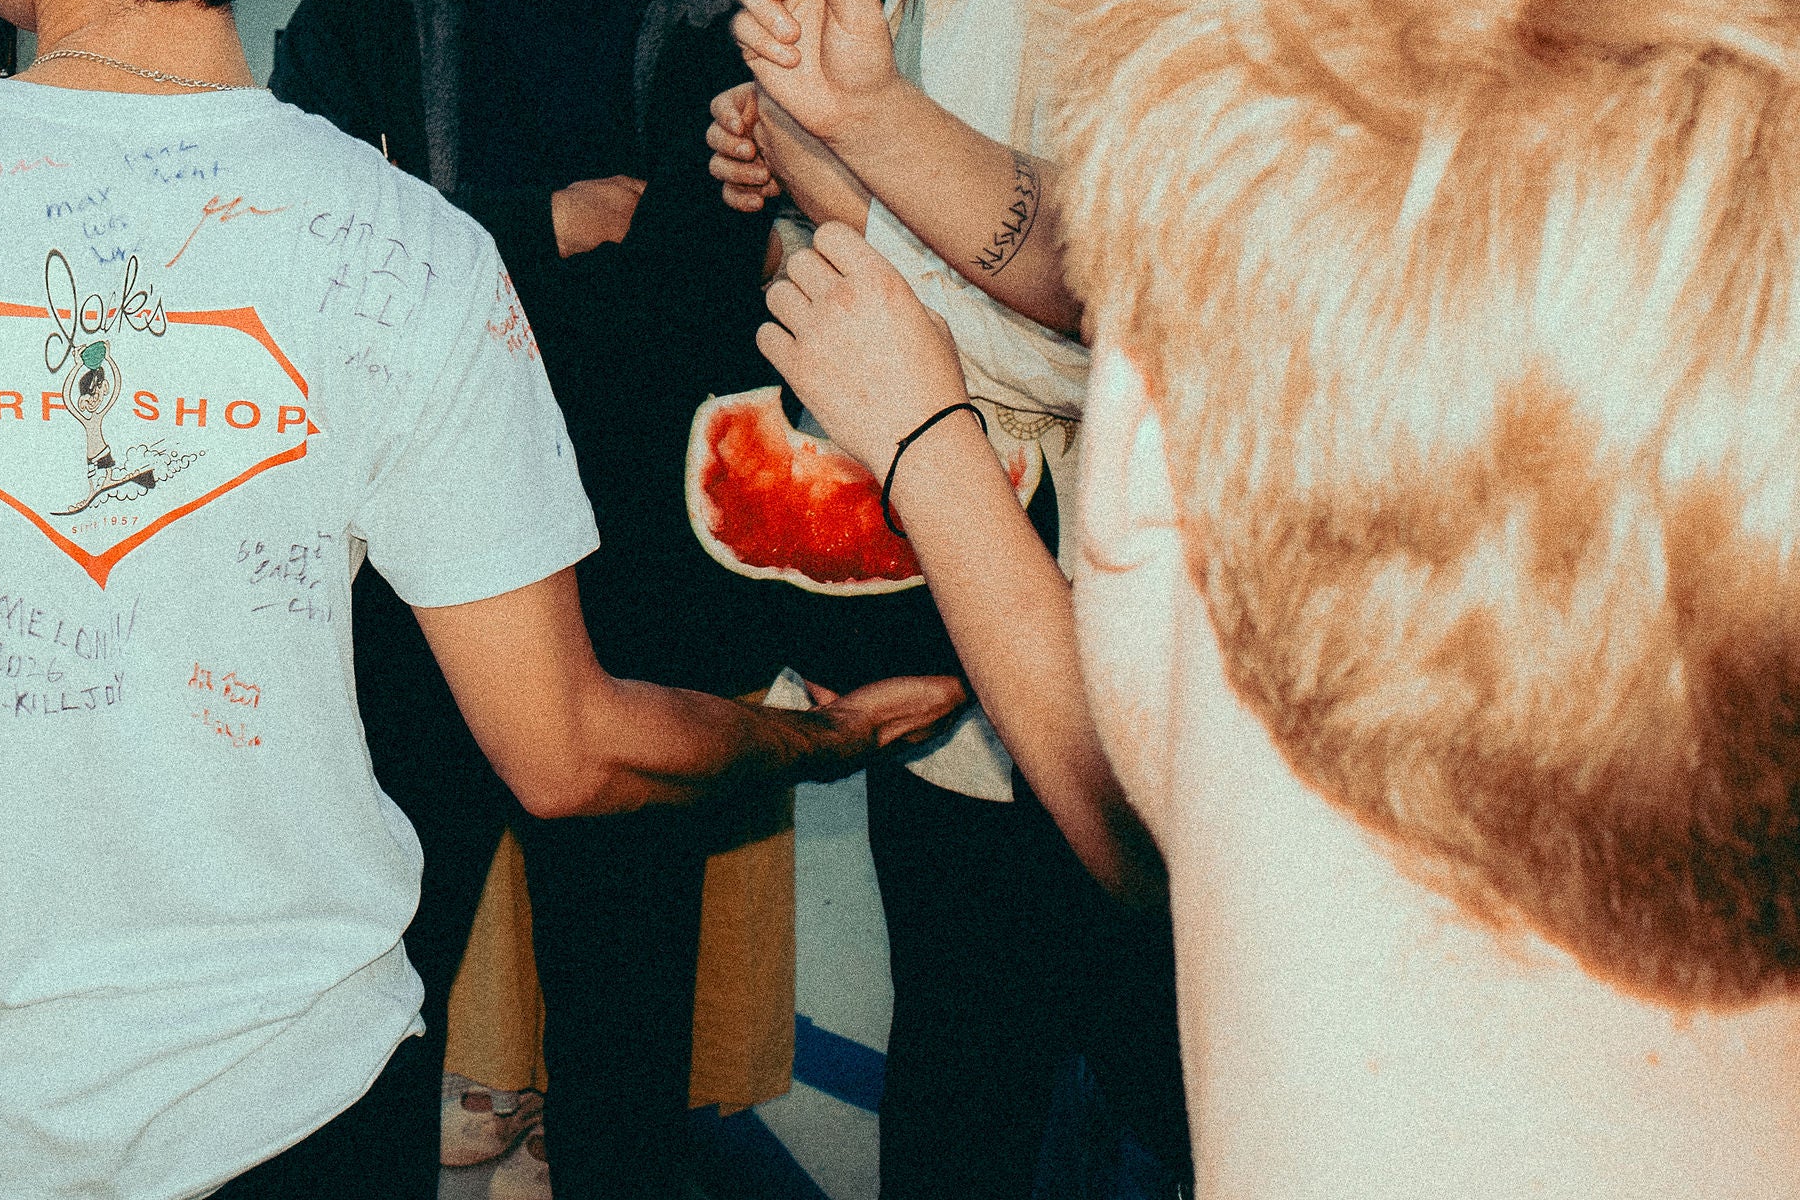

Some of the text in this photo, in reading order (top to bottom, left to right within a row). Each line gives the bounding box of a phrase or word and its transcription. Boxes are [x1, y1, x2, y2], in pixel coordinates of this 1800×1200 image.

[45, 248, 168, 373] Jack's
[133, 390, 308, 434] SHOP
[102, 515, 139, 527] 1957
